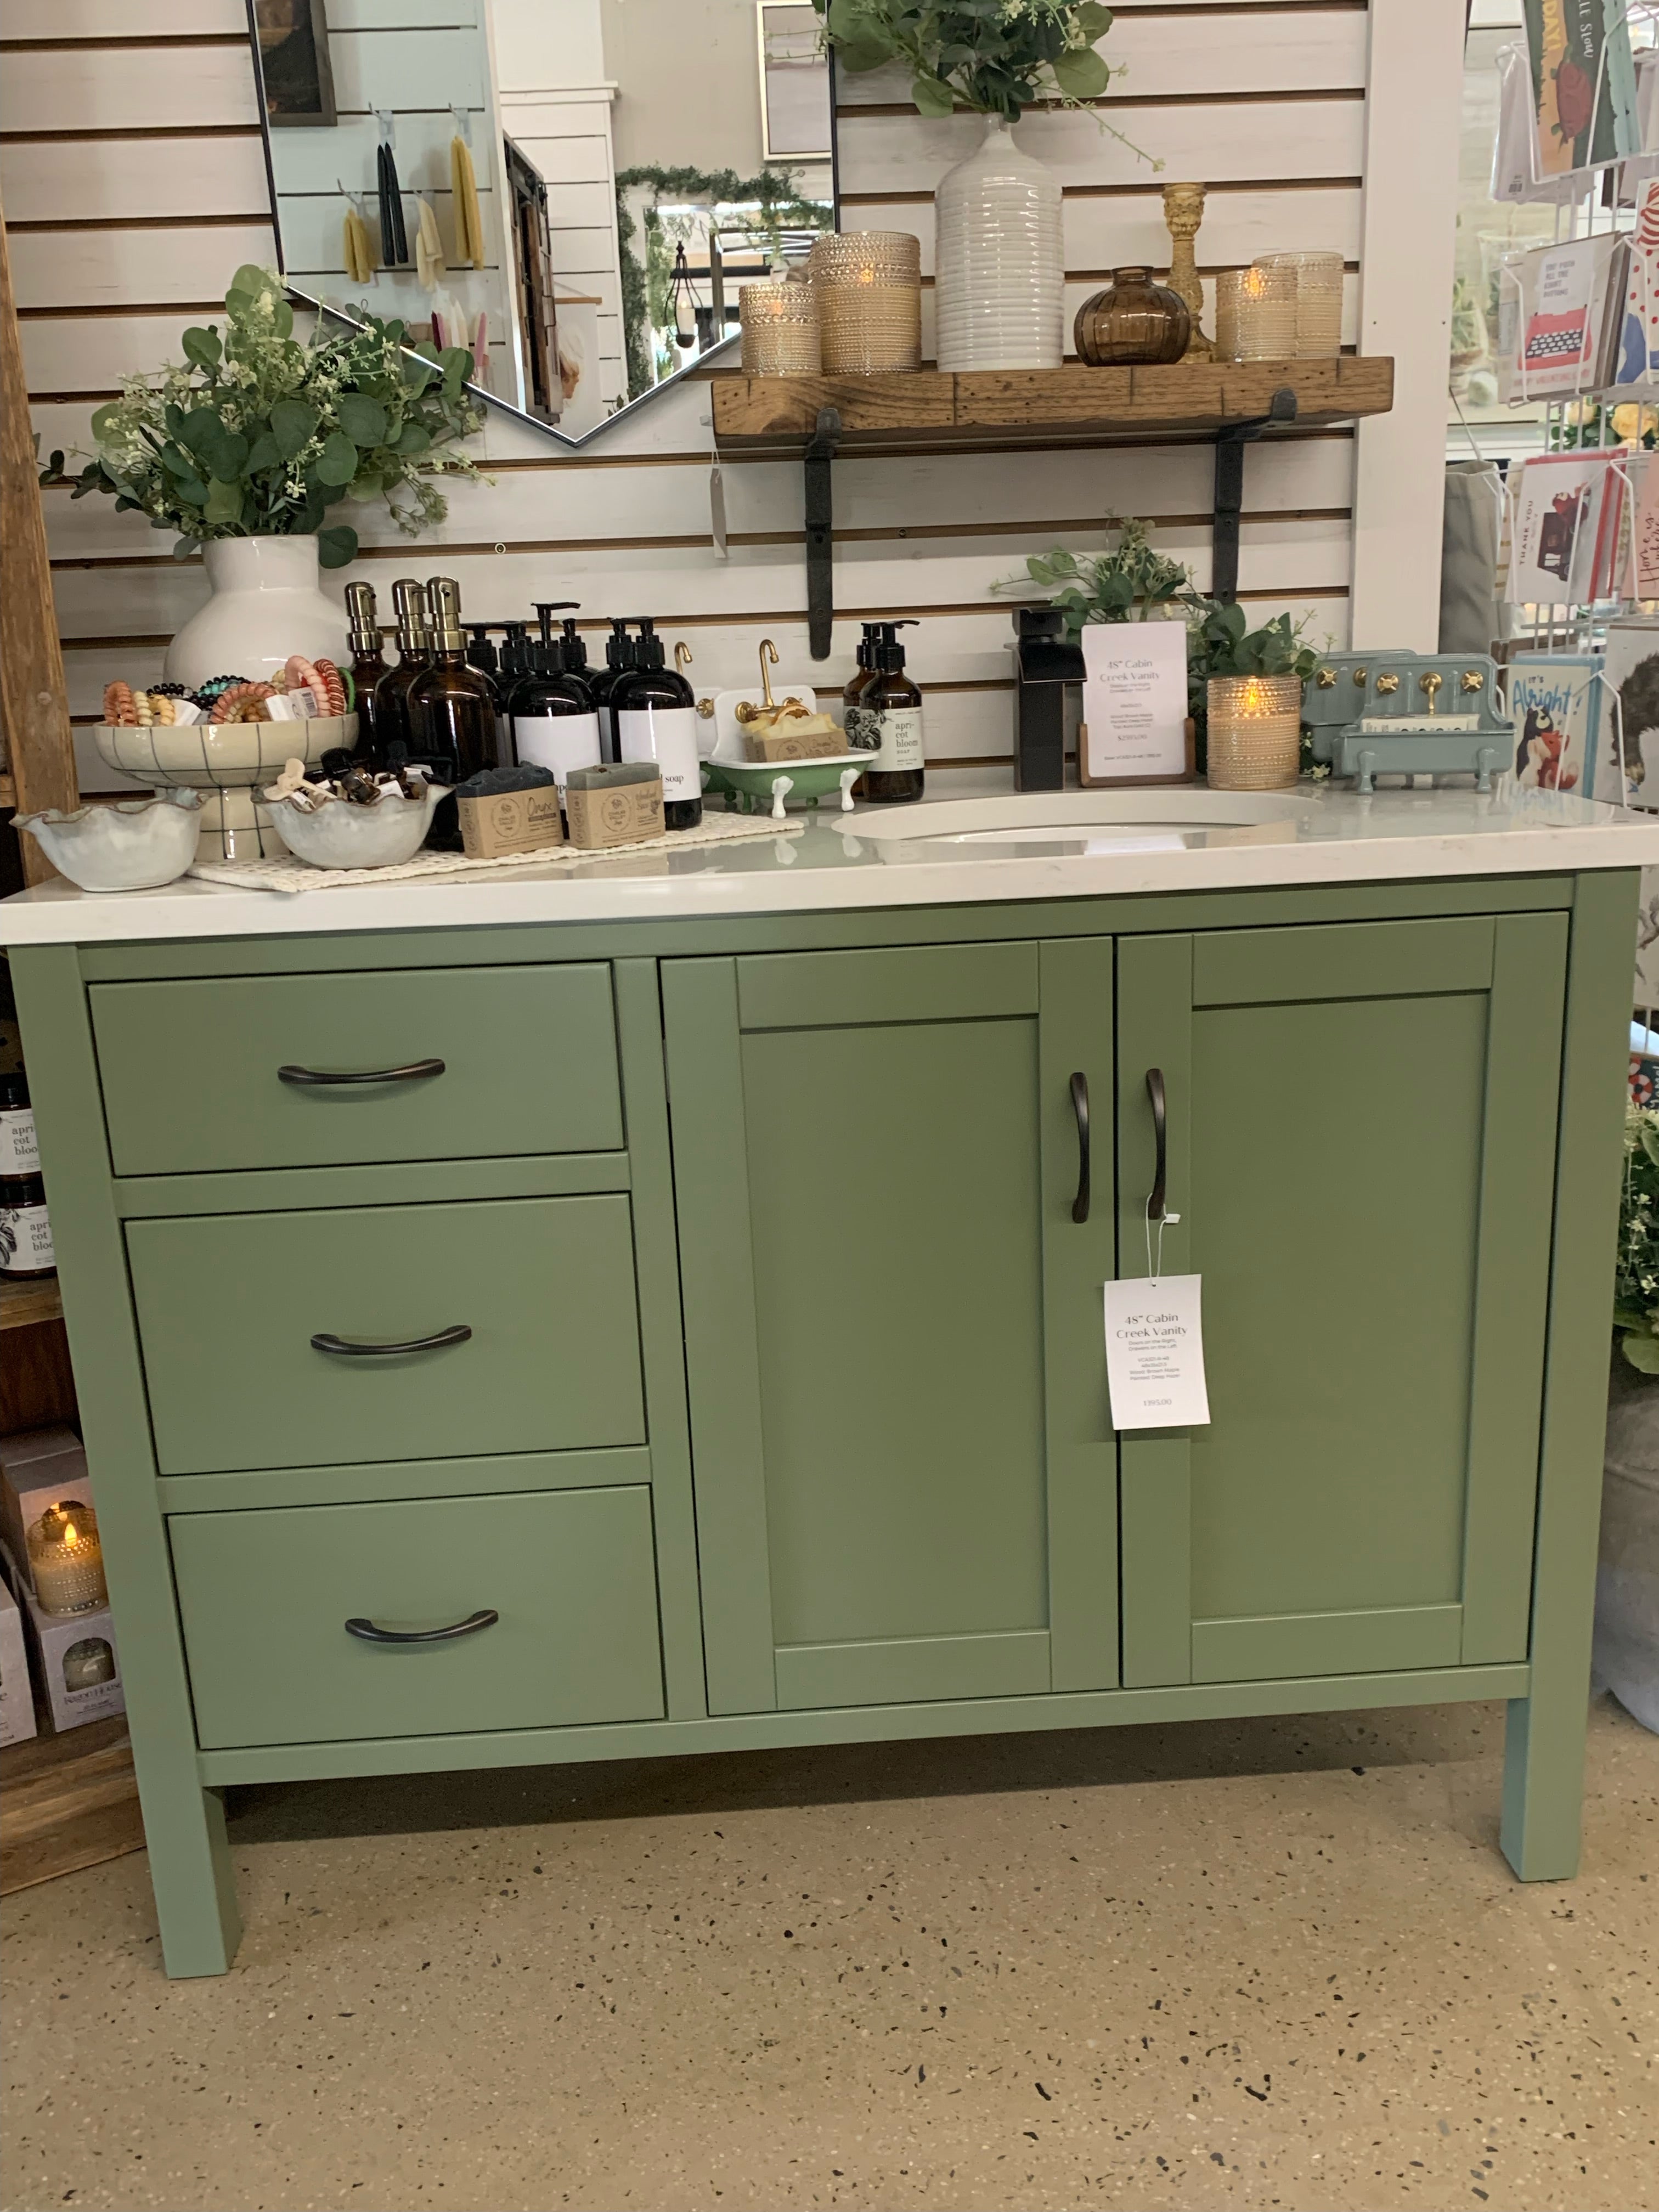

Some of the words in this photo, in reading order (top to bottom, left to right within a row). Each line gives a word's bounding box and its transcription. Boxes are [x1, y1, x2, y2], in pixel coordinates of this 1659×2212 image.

[1519, 527, 1530, 565] THANK
[1125, 660, 1153, 668] Cabin
[1100, 673, 1128, 682] Creek
[1131, 672, 1159, 680] Vanity
[895, 720, 915, 731] apri-
[896, 739, 918, 747] bloom
[665, 775, 684, 785] soap
[527, 797, 552, 816] Onyx
[13, 1137, 30, 1145] cot
[14, 1146, 37, 1155] bloo
[31, 1232, 48, 1241] cot
[1146, 1314, 1178, 1323] Cabin
[1116, 1328, 1150, 1339] Creek
[1153, 1327, 1187, 1337] Vanity
